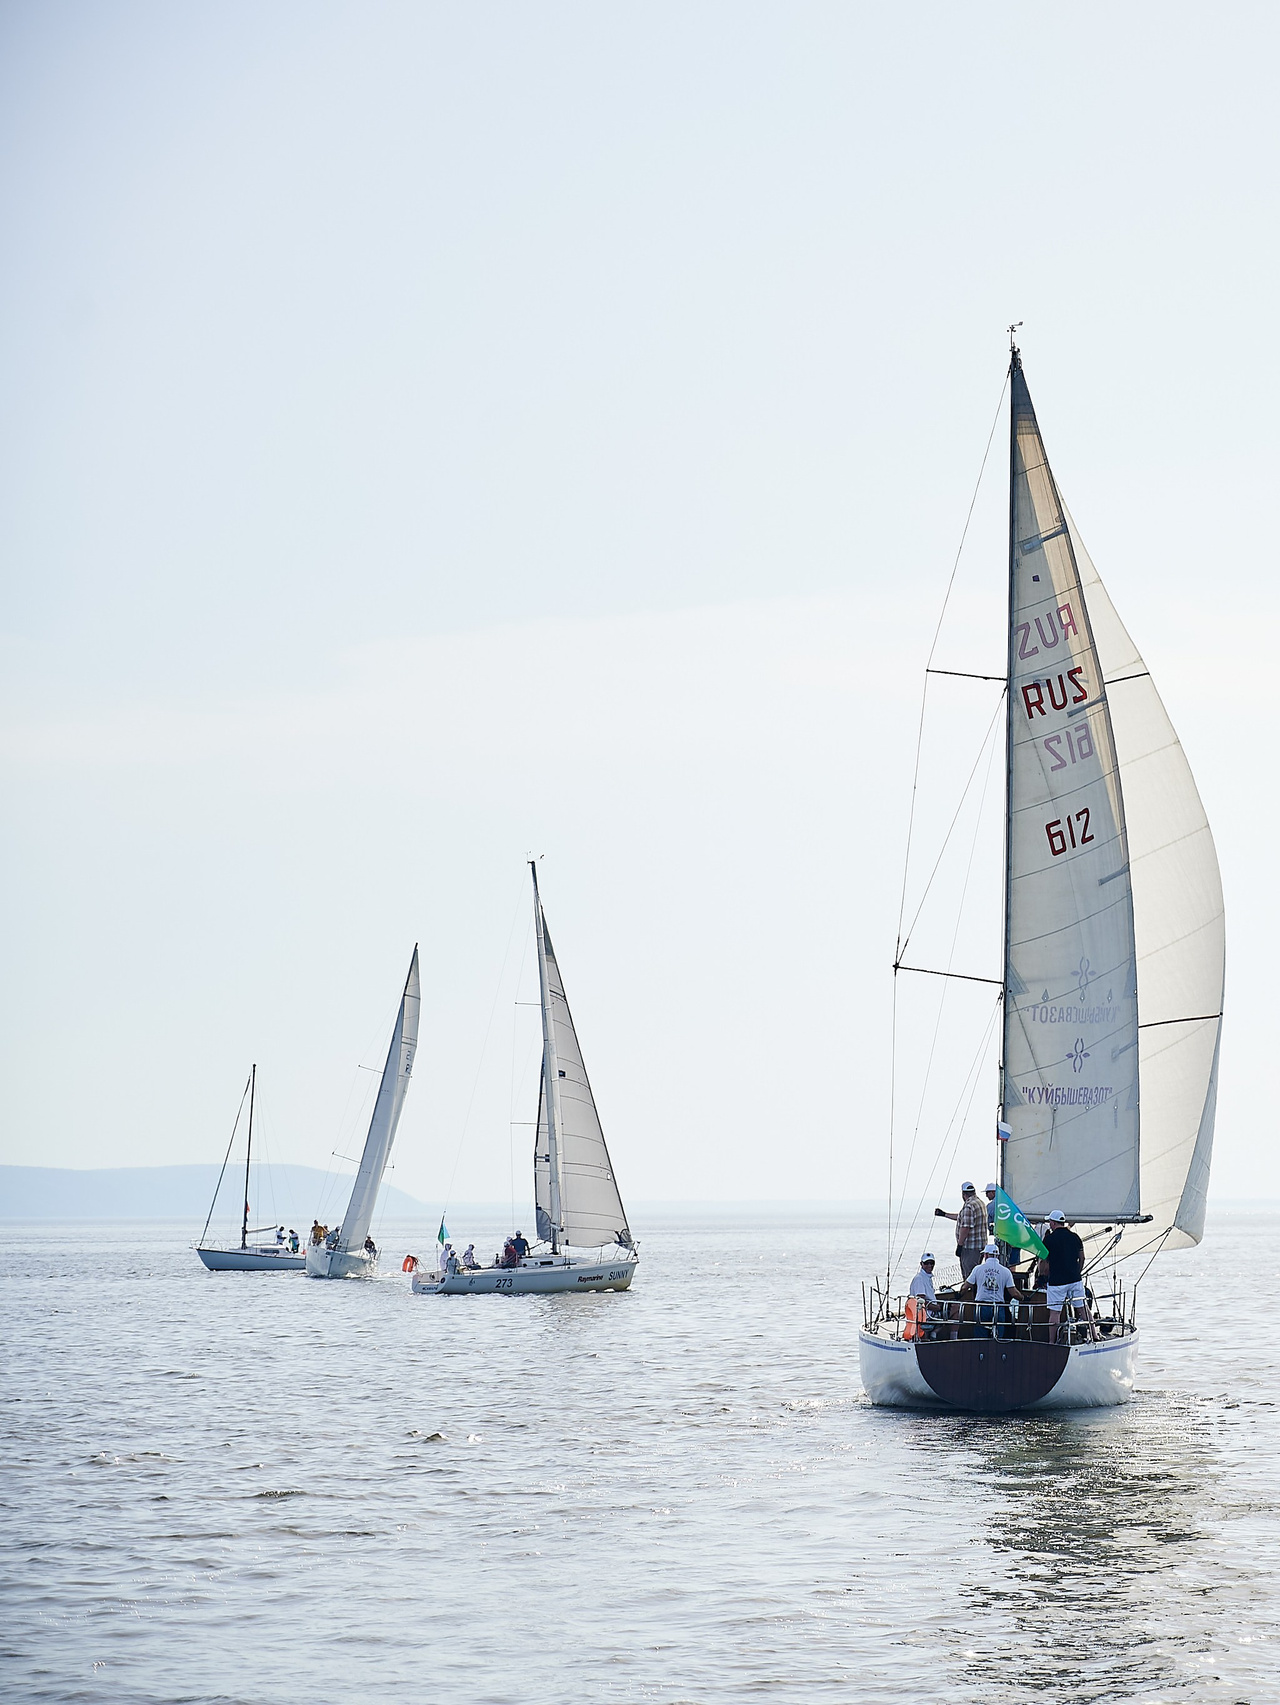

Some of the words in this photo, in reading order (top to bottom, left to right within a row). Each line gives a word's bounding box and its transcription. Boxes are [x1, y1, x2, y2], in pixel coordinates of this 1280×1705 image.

[1021, 666, 1088, 719] RUS
[1045, 807, 1095, 856] 612
[495, 1278, 513, 1289] 273
[608, 1269, 630, 1281] SUNNY
